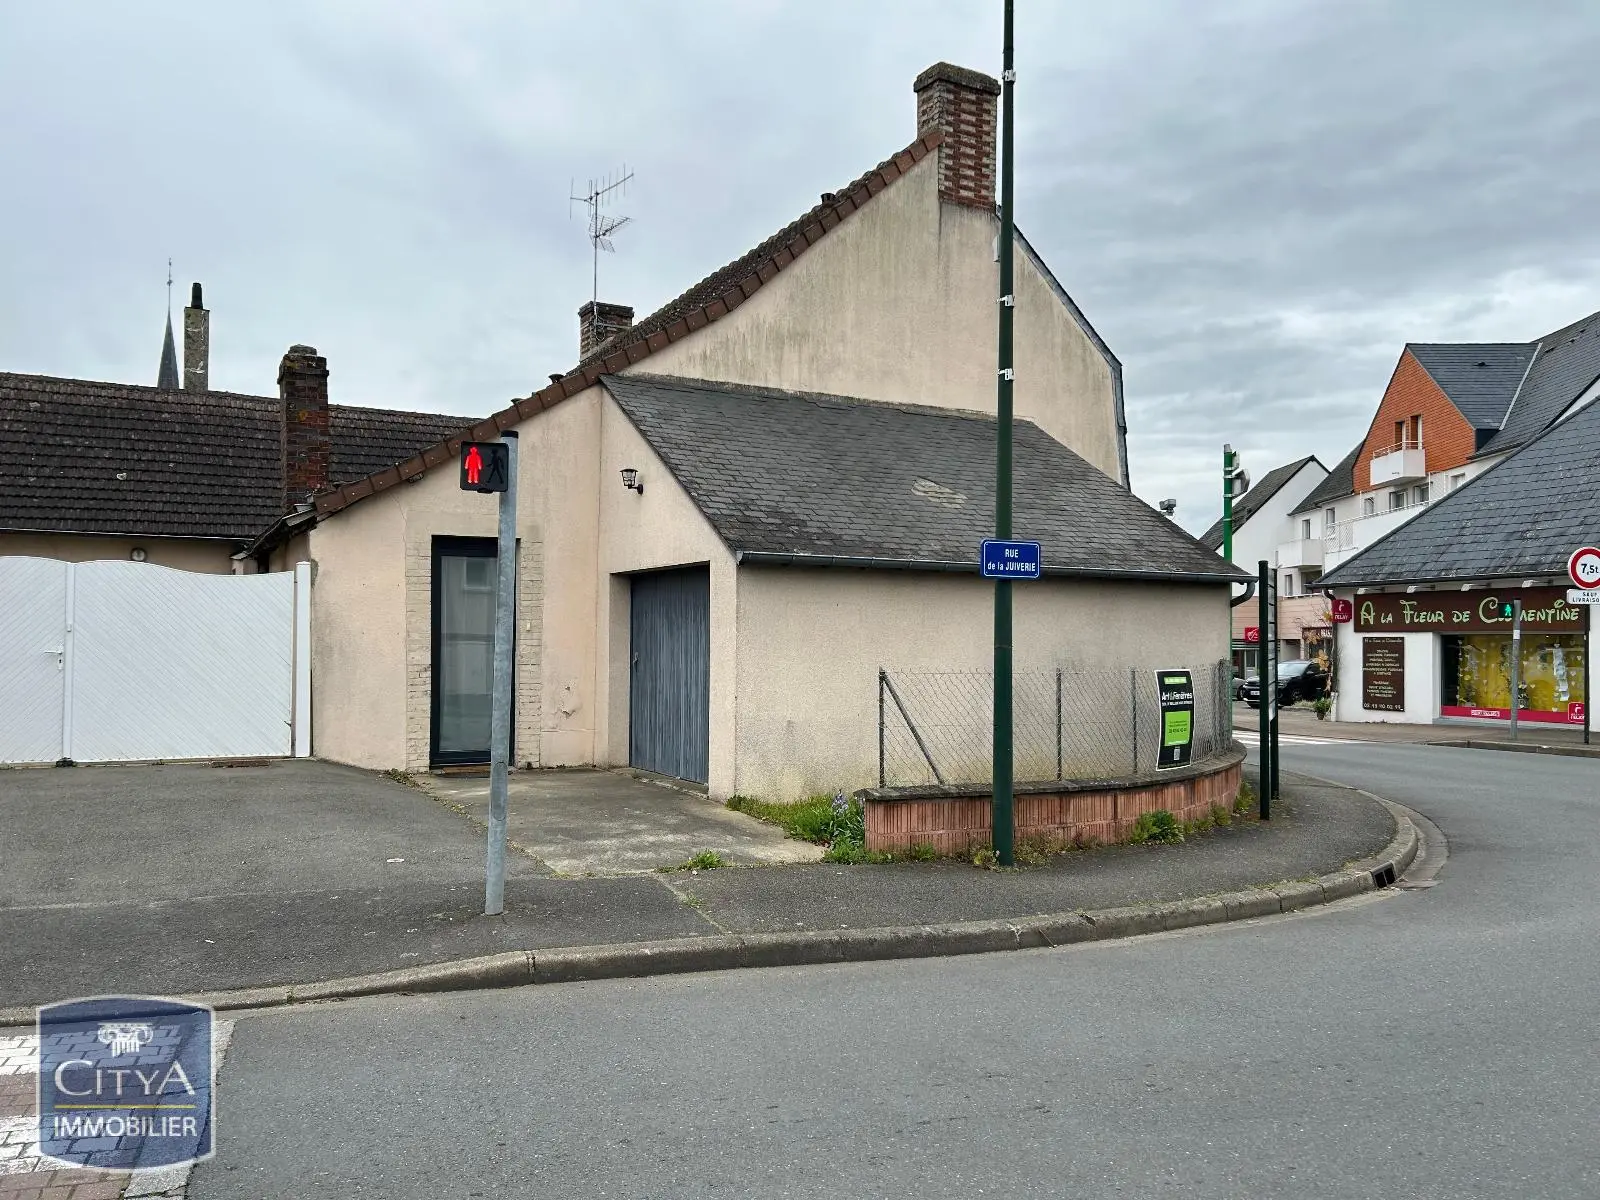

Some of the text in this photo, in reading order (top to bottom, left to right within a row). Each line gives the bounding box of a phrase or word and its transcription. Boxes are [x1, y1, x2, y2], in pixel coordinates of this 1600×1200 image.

[1005, 548, 1019, 558] RUE
[987, 561, 1036, 572] de la JUIVERIE
[1580, 563, 1599, 575] 7,5t
[1360, 596, 1580, 625] A LA FLEUR DE CMENTINE
